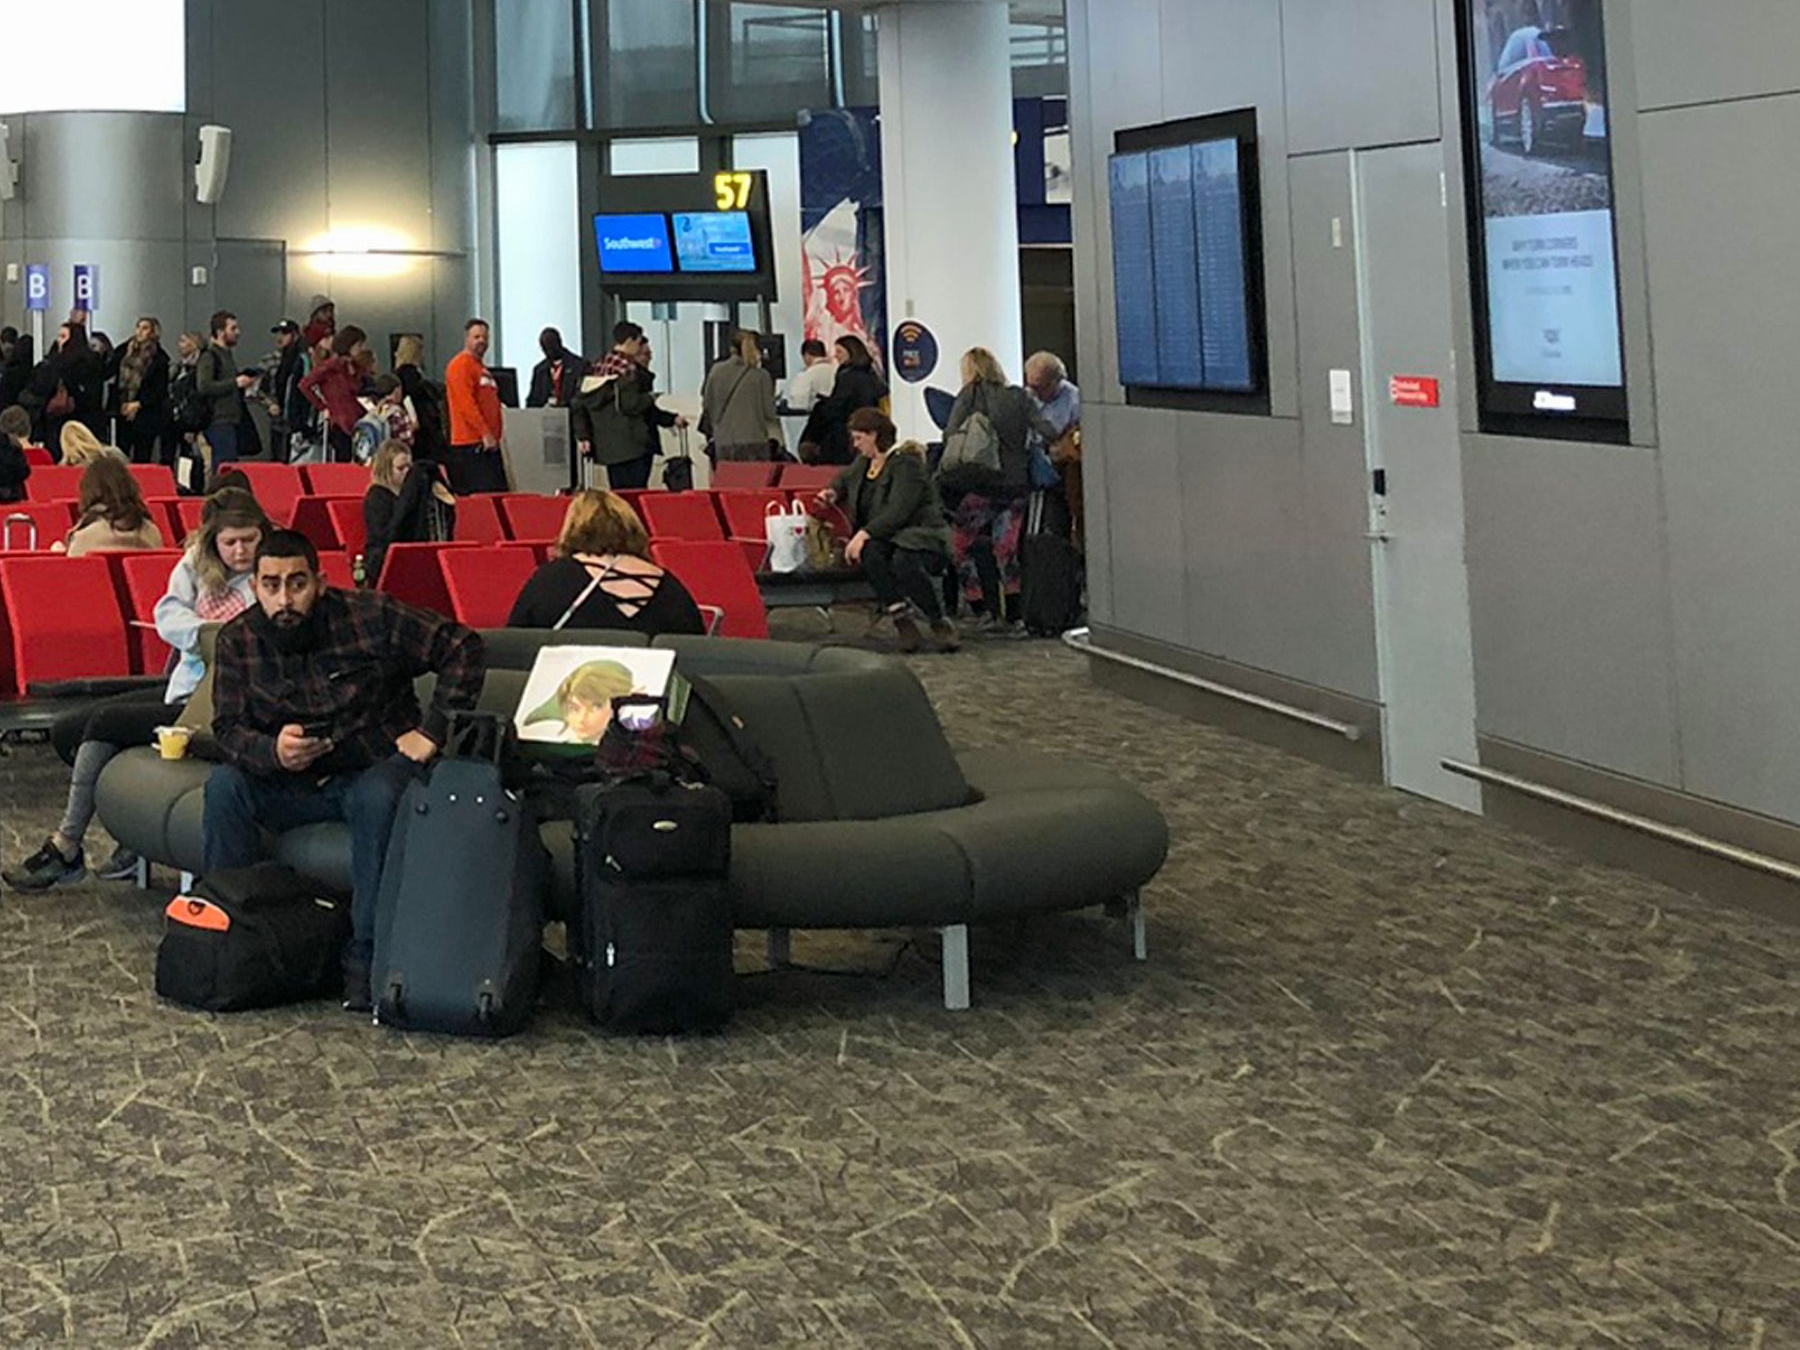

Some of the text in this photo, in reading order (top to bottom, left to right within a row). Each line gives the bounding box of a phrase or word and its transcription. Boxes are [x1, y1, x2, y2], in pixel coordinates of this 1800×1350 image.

[714, 172, 752, 211] 57
[603, 236, 654, 250] Southwest
[29, 272, 46, 299] B
[77, 274, 92, 299] B
